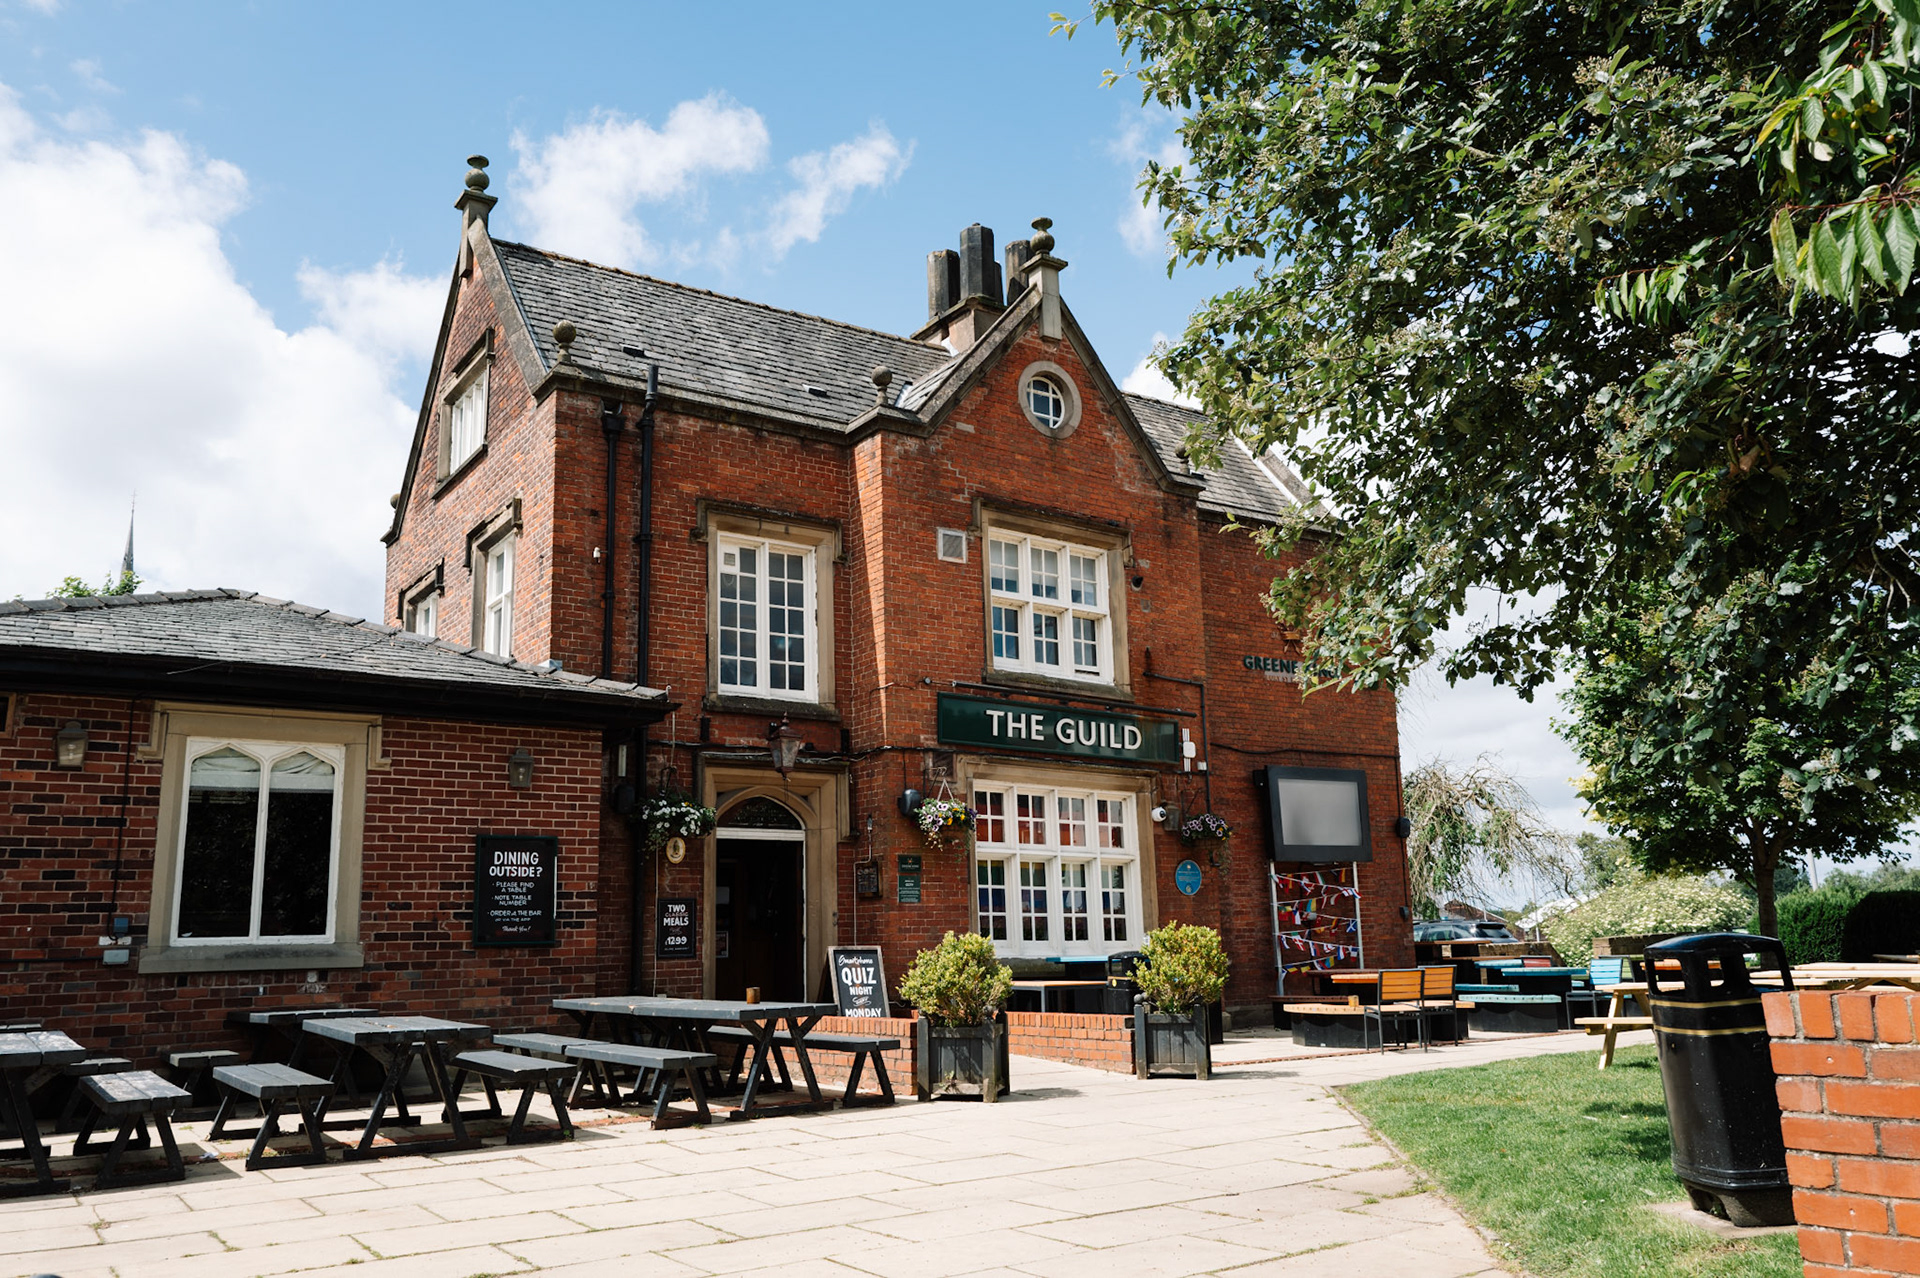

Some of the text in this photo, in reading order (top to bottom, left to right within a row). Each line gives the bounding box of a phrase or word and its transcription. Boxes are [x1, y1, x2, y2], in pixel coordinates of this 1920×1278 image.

[1243, 655, 1298, 674] GREENE
[986, 709, 1142, 750] THE GUILD
[494, 851, 539, 865] DINING
[489, 866, 543, 877] OUTSIDE?
[667, 904, 686, 912] TWO
[663, 917, 689, 926] MEALS
[841, 967, 877, 986] QUIZ
[849, 986, 873, 995] NIGHT
[845, 1008, 881, 1017] MONDAY
